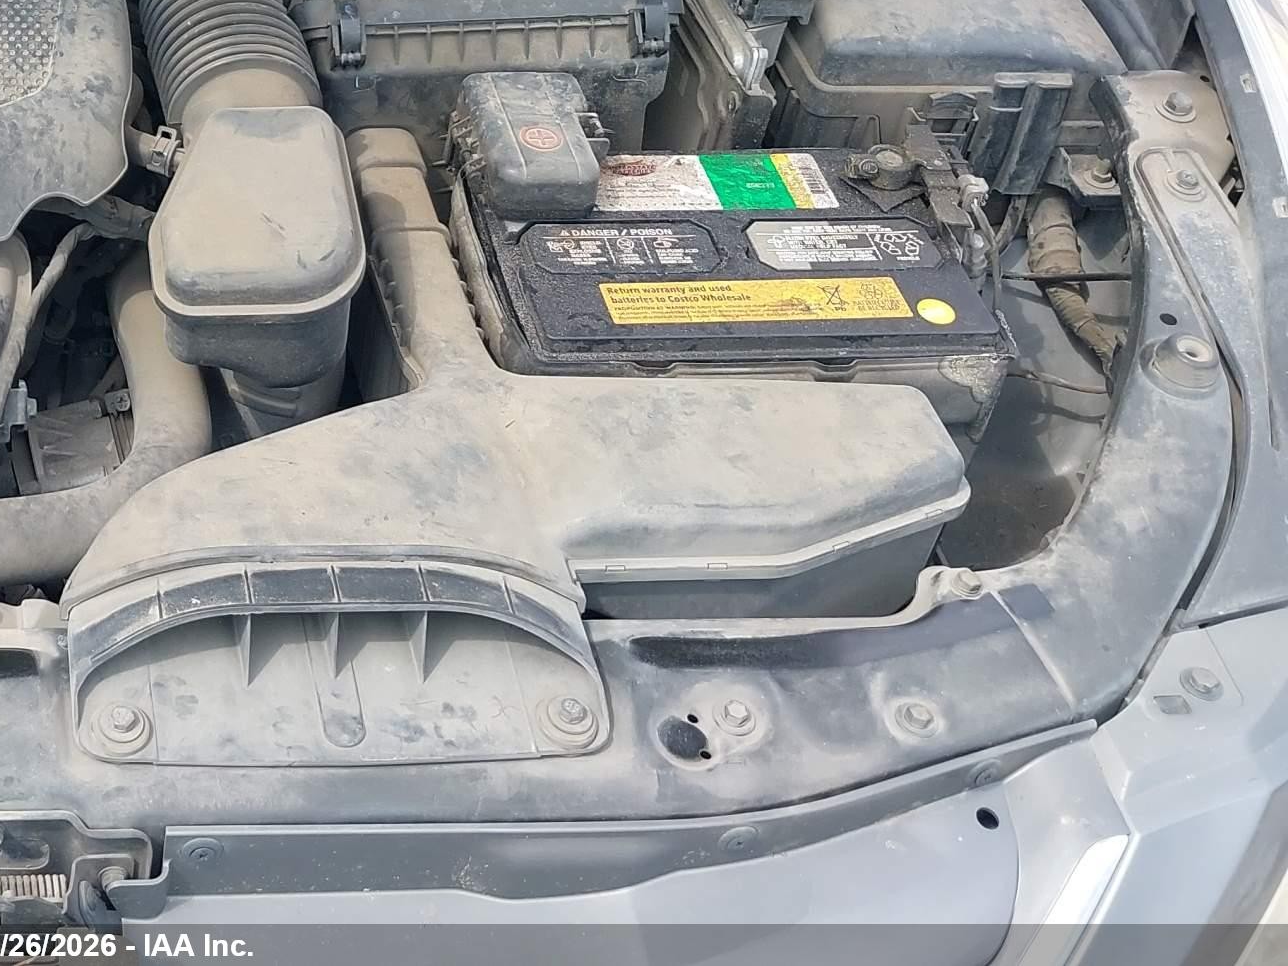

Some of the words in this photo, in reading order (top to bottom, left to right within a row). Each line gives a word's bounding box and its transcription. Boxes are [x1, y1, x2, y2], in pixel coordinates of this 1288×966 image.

[630, 228, 673, 236] POISON
[642, 286, 685, 295] warranty
[689, 285, 706, 293] and
[708, 284, 732, 292] used
[611, 296, 654, 304] batteries
[656, 295, 666, 303] to
[668, 295, 699, 303] Costco
[701, 293, 751, 302] Wholesale
